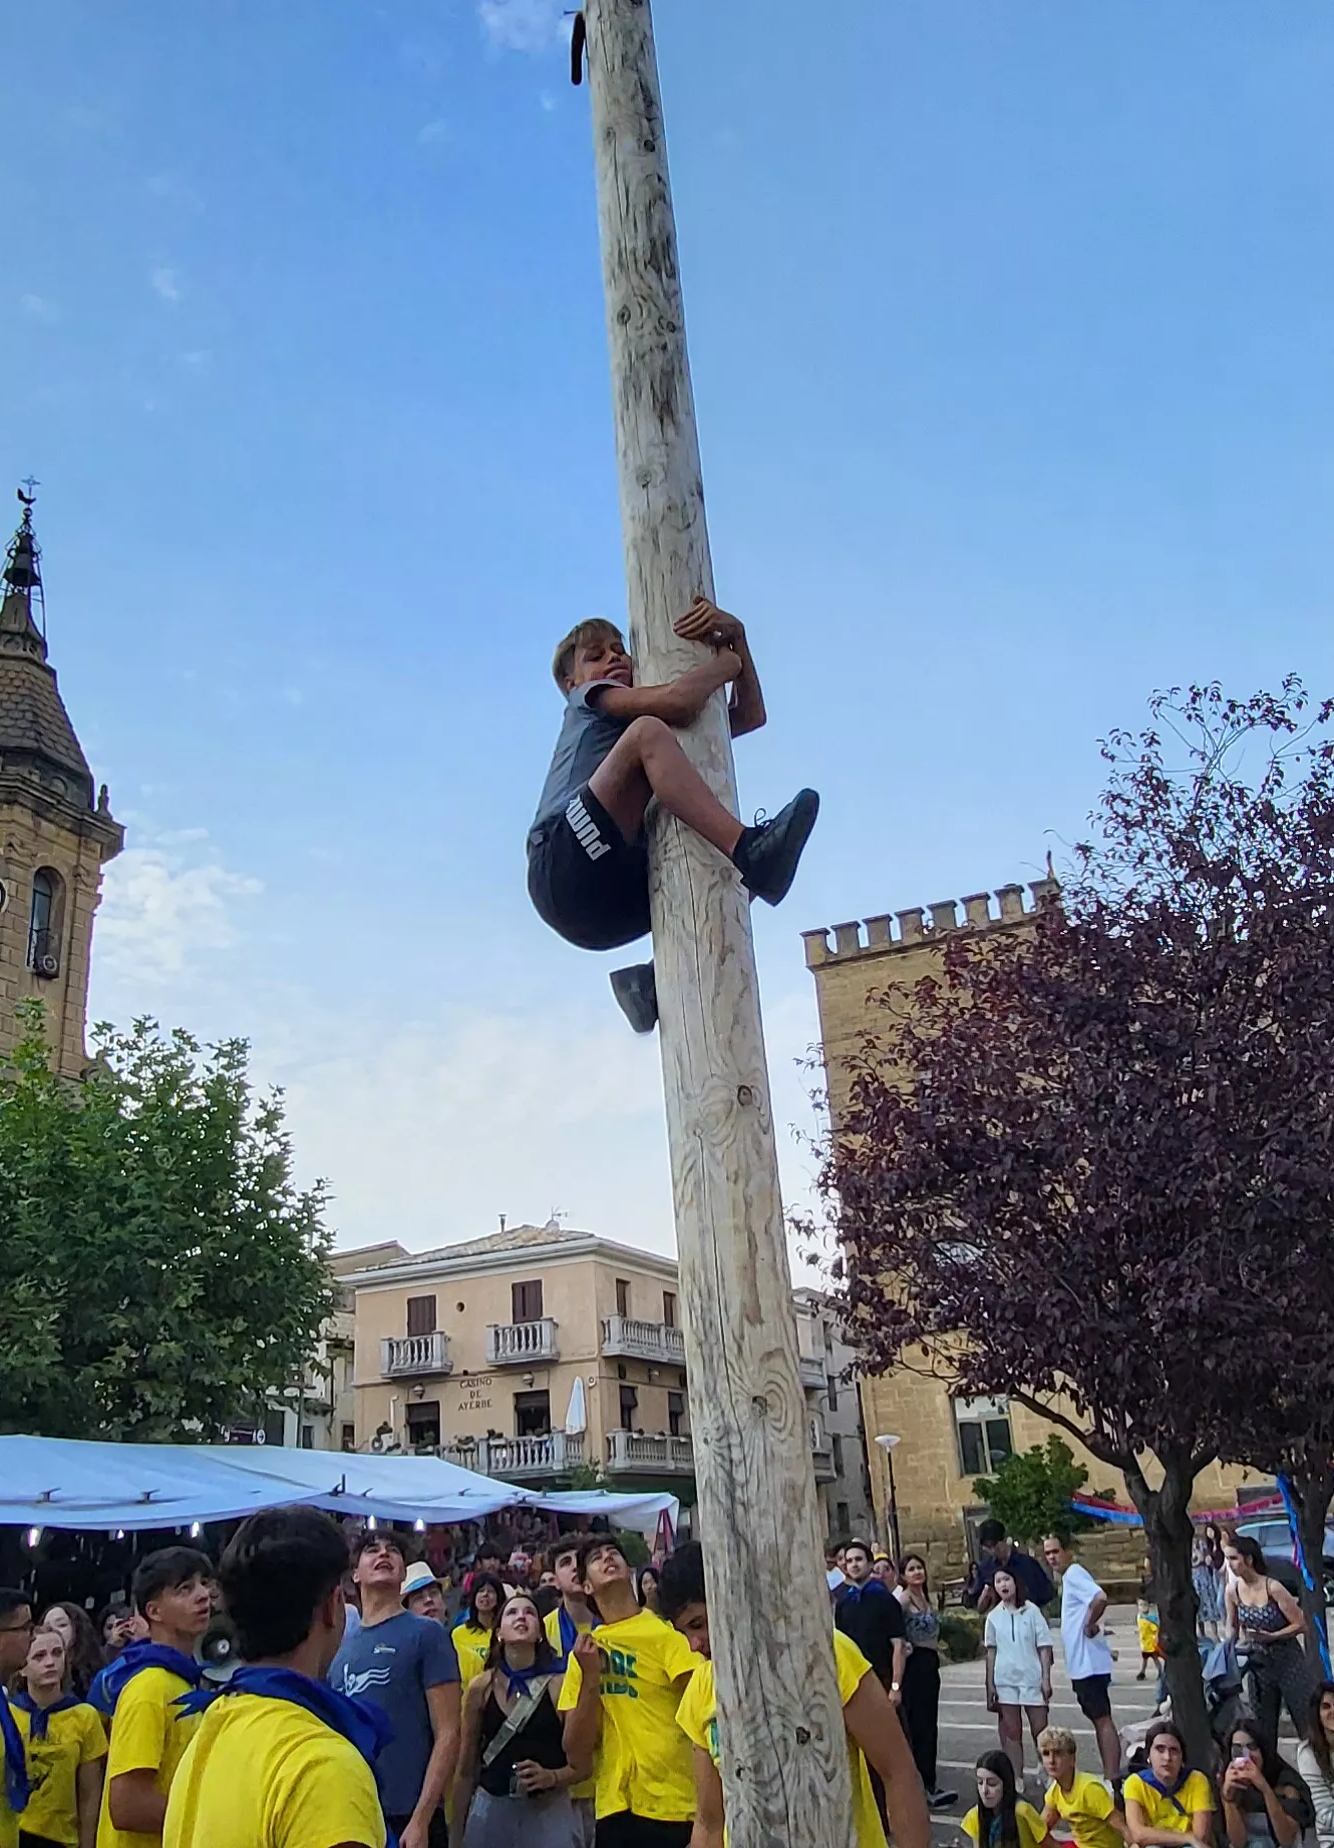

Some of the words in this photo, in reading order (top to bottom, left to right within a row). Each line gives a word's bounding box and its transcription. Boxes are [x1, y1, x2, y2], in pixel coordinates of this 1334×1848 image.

[459, 1376, 493, 1389] CASINO
[469, 1390, 482, 1399] DE
[457, 1399, 494, 1411] AYERBE
